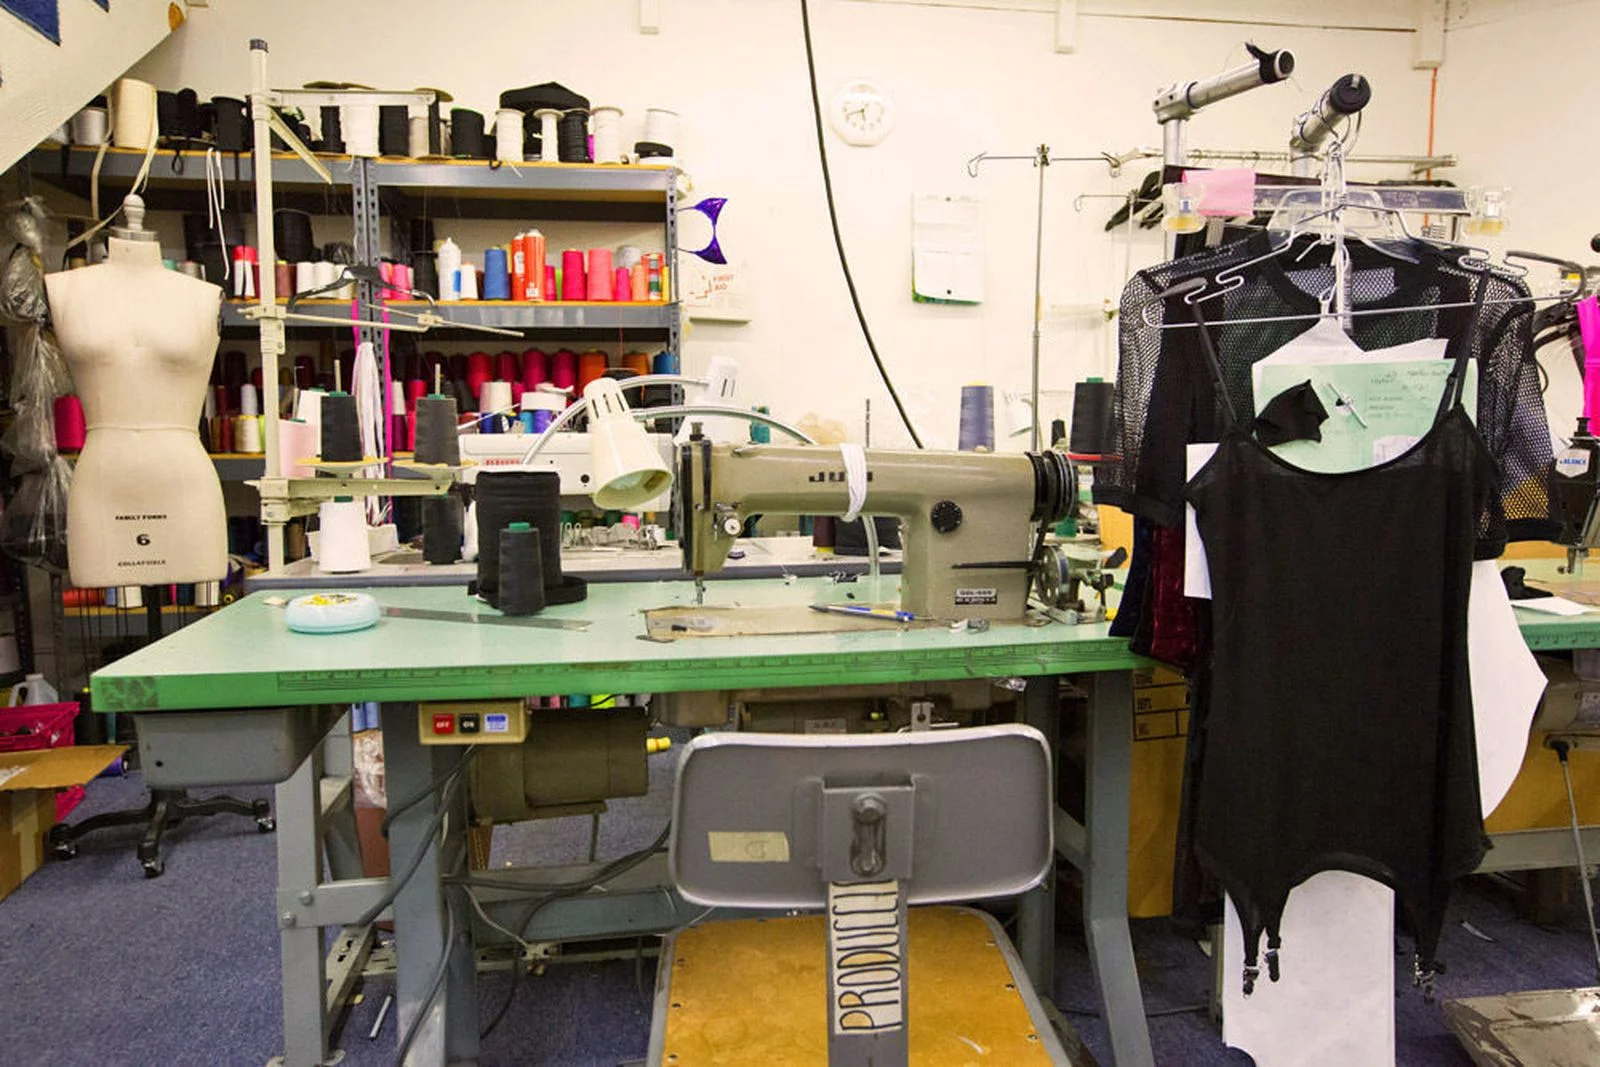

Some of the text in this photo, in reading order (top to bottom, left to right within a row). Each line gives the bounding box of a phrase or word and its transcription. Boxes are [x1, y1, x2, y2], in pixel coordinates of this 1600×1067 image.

[808, 471, 874, 482] JUI
[136, 533, 151, 546] 6
[436, 720, 450, 729] OFF
[462, 720, 475, 728] ON
